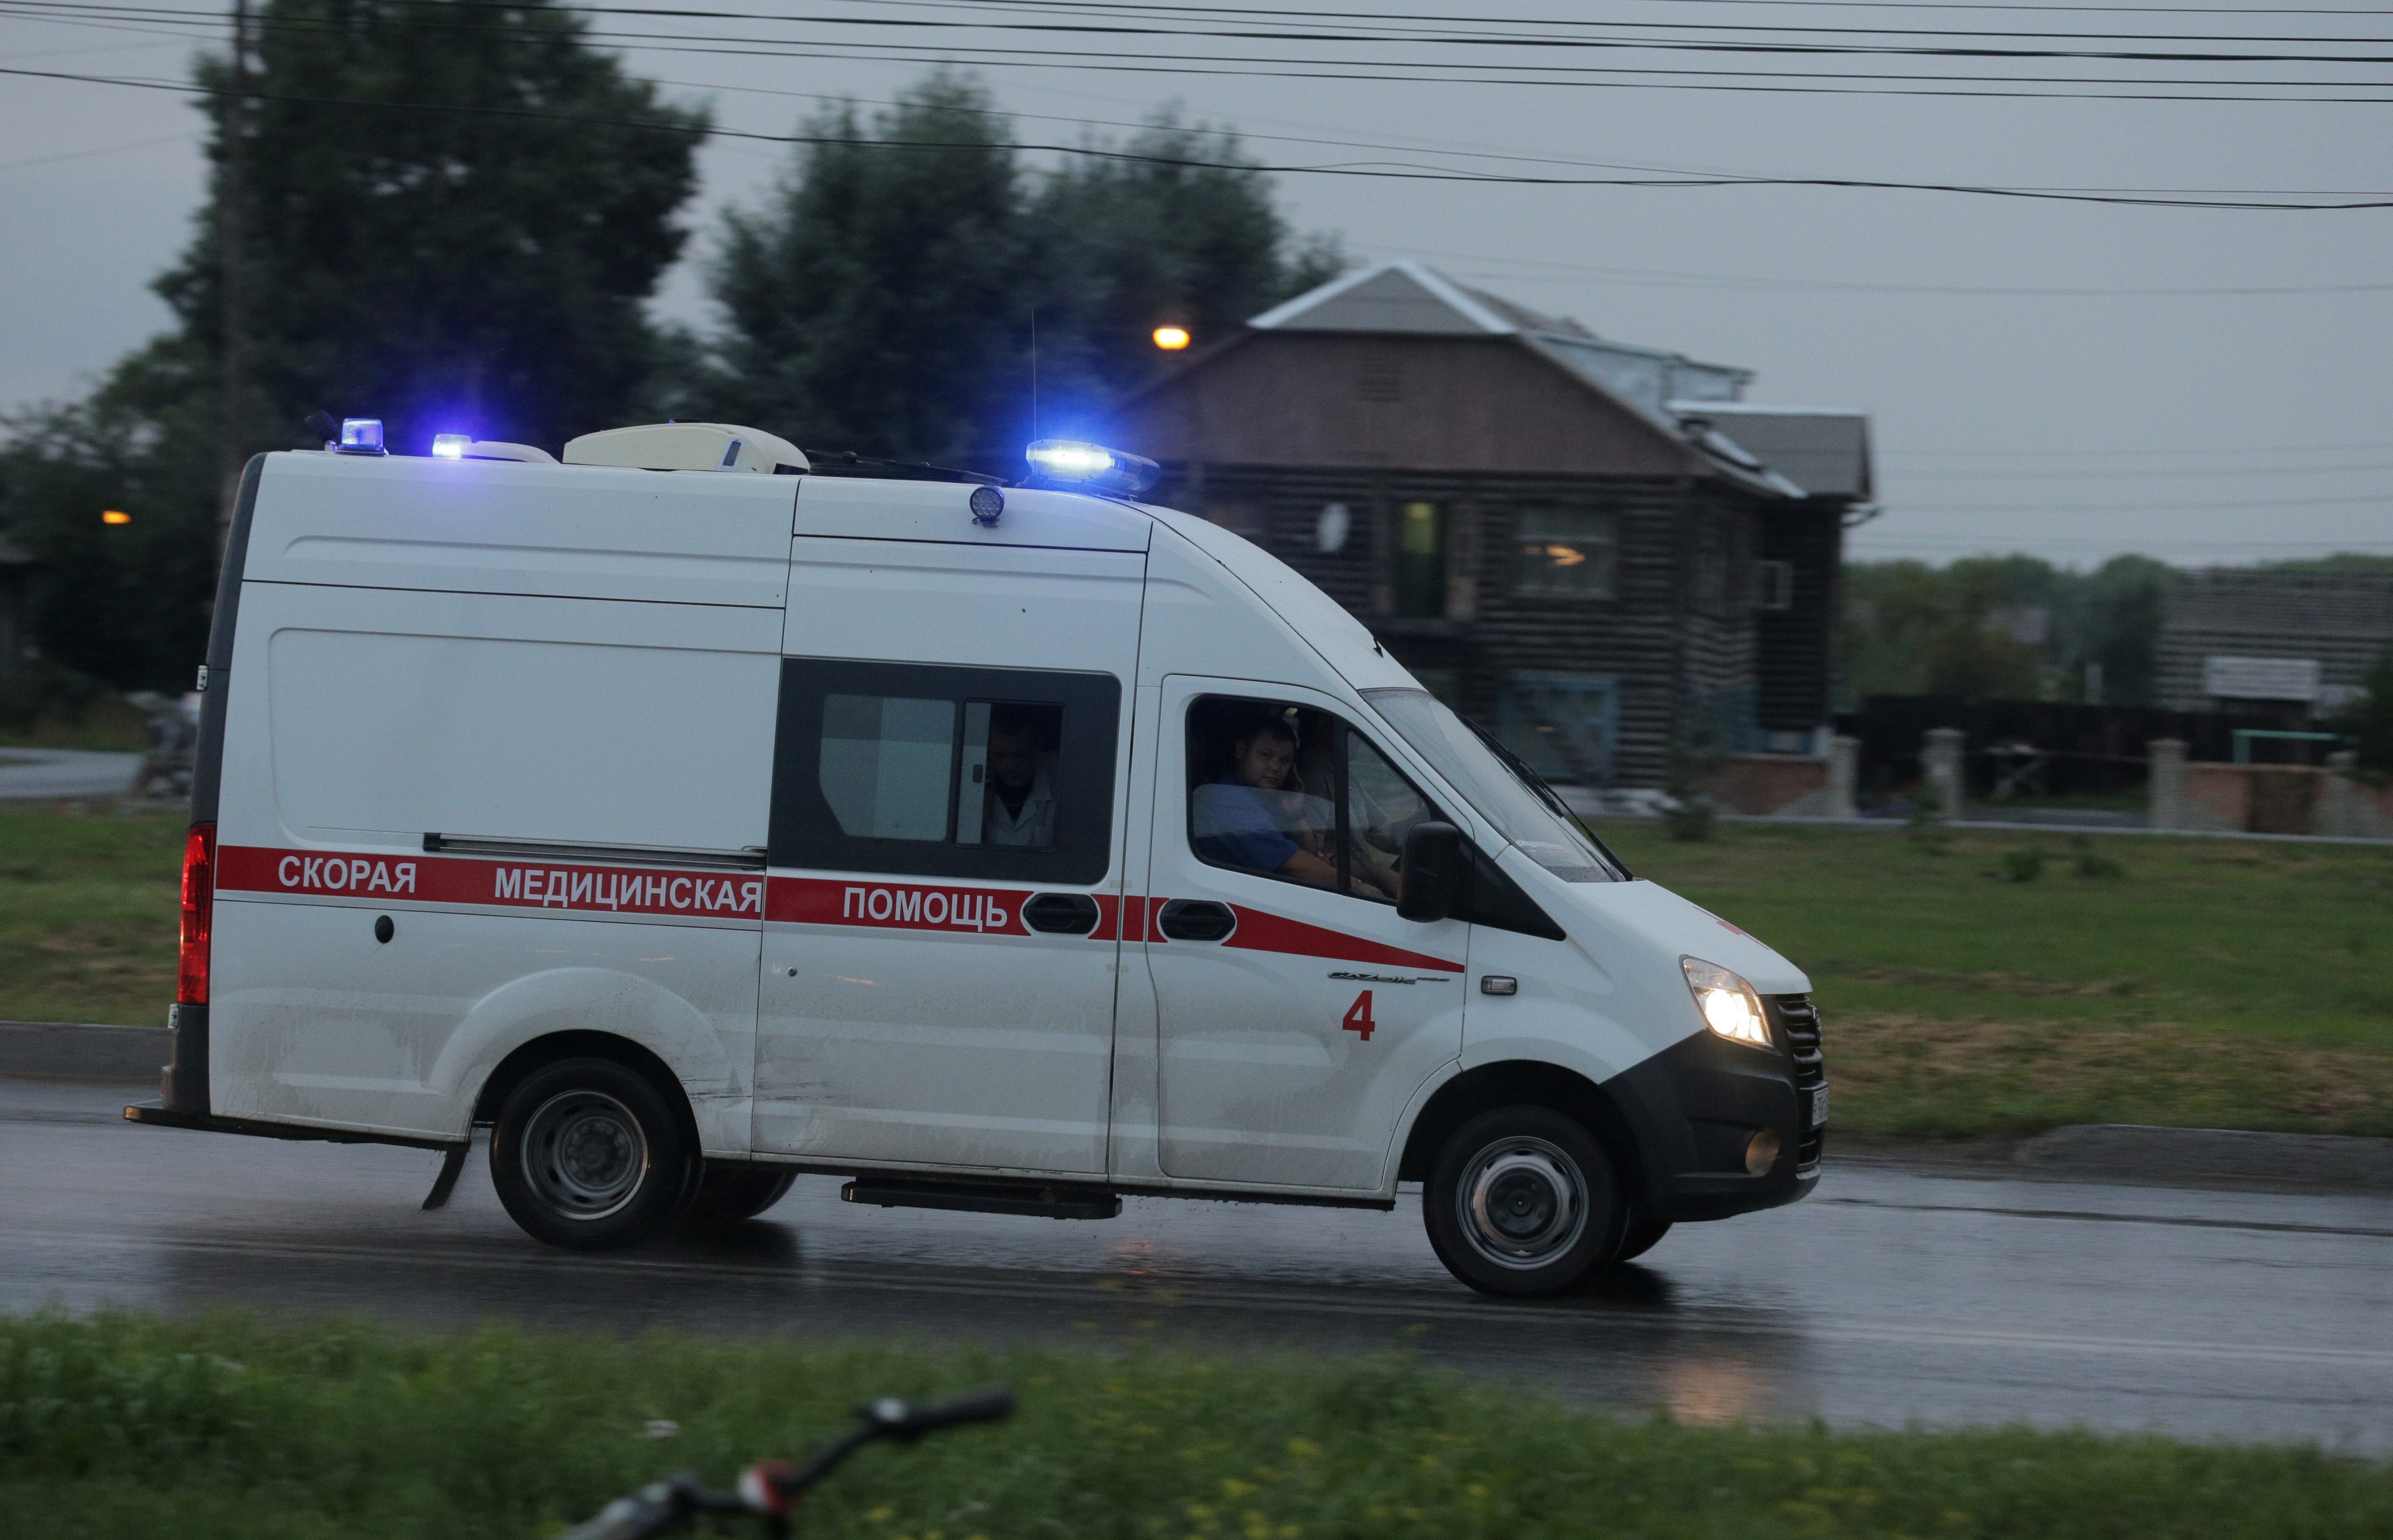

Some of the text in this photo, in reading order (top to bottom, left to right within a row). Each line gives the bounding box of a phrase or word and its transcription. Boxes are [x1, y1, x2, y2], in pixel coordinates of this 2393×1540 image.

[278, 855, 1008, 932] СКОРАЯ МЕДИЦИНСКАЯ ПОМОЩЬ
[1342, 990, 1375, 1041] 4
